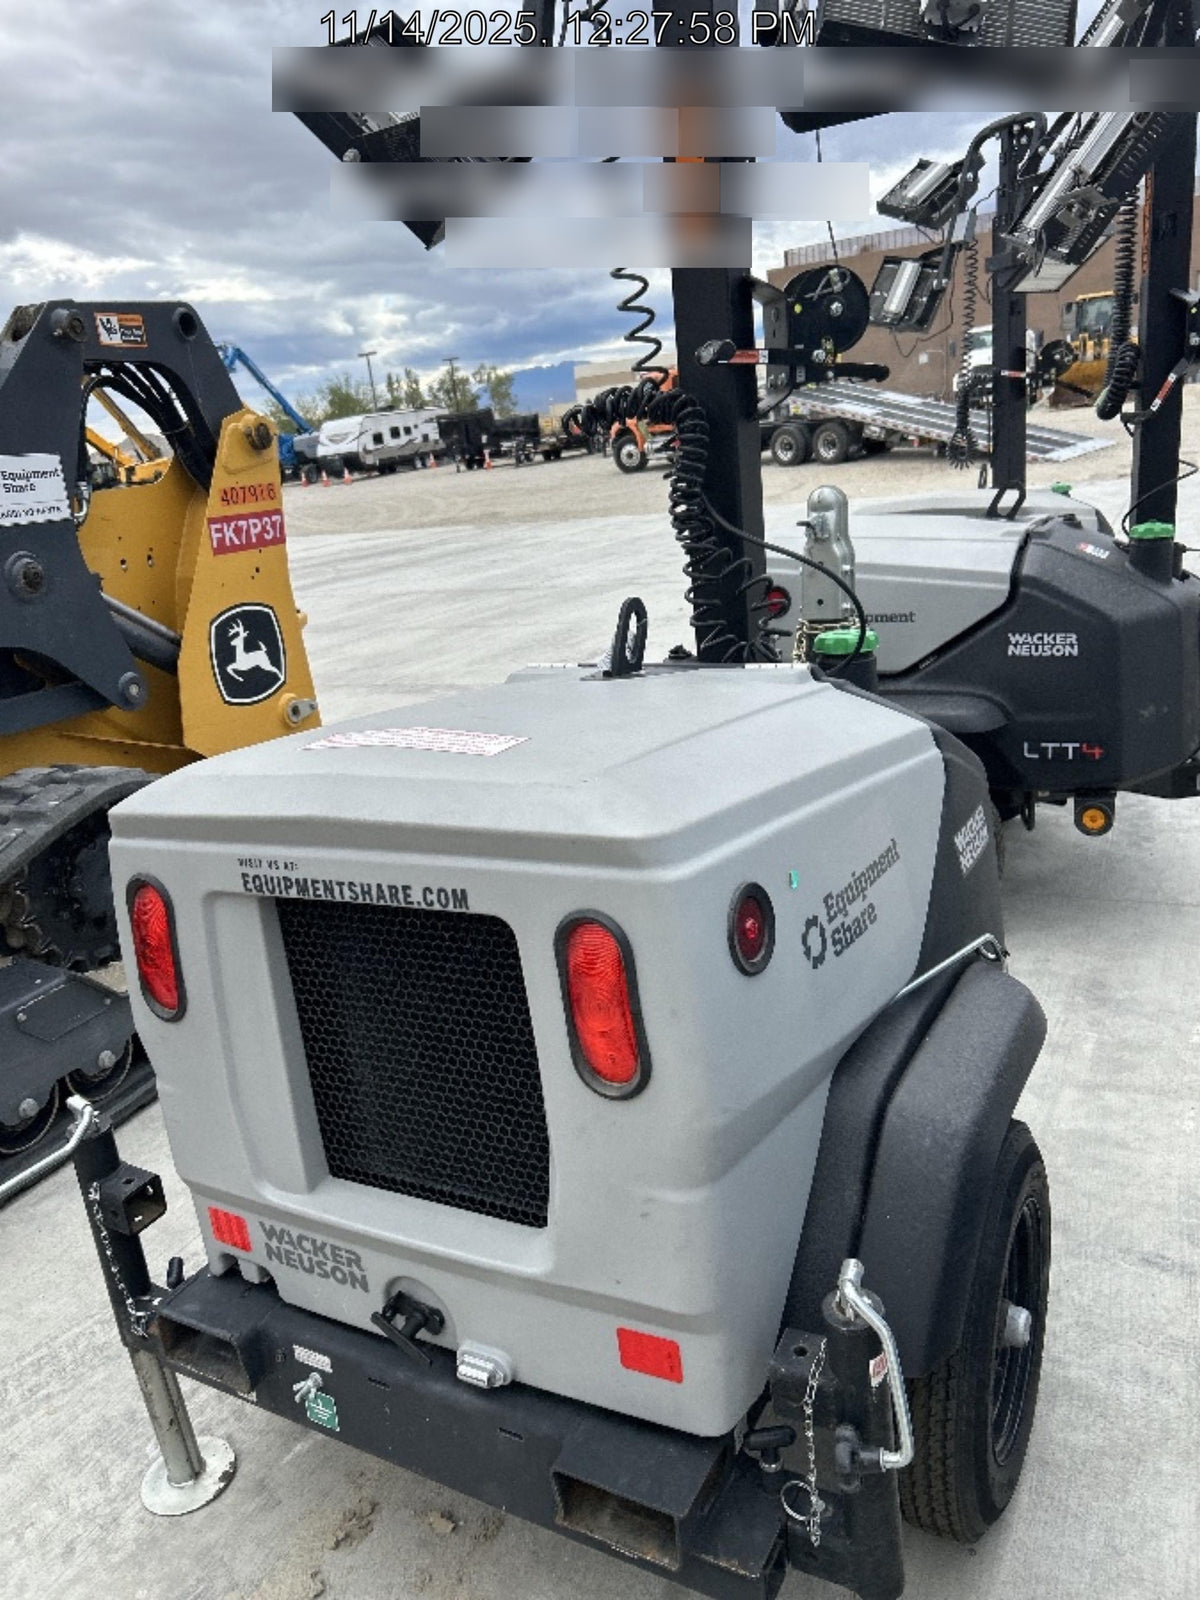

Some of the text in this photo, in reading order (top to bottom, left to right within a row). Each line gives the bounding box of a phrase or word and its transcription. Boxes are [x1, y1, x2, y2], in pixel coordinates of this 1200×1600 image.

[210, 514, 281, 549] FK7P37
[1007, 632, 1078, 645] WACKER
[1007, 644, 1079, 657] NEUSON
[1023, 741, 1103, 760] LTT4
[241, 872, 470, 911] EQUIPMENTSHARE.COM
[823, 838, 900, 925] Equipment
[831, 902, 878, 958] Share
[258, 1220, 366, 1272] WACKER
[264, 1242, 370, 1293] NEUSON
